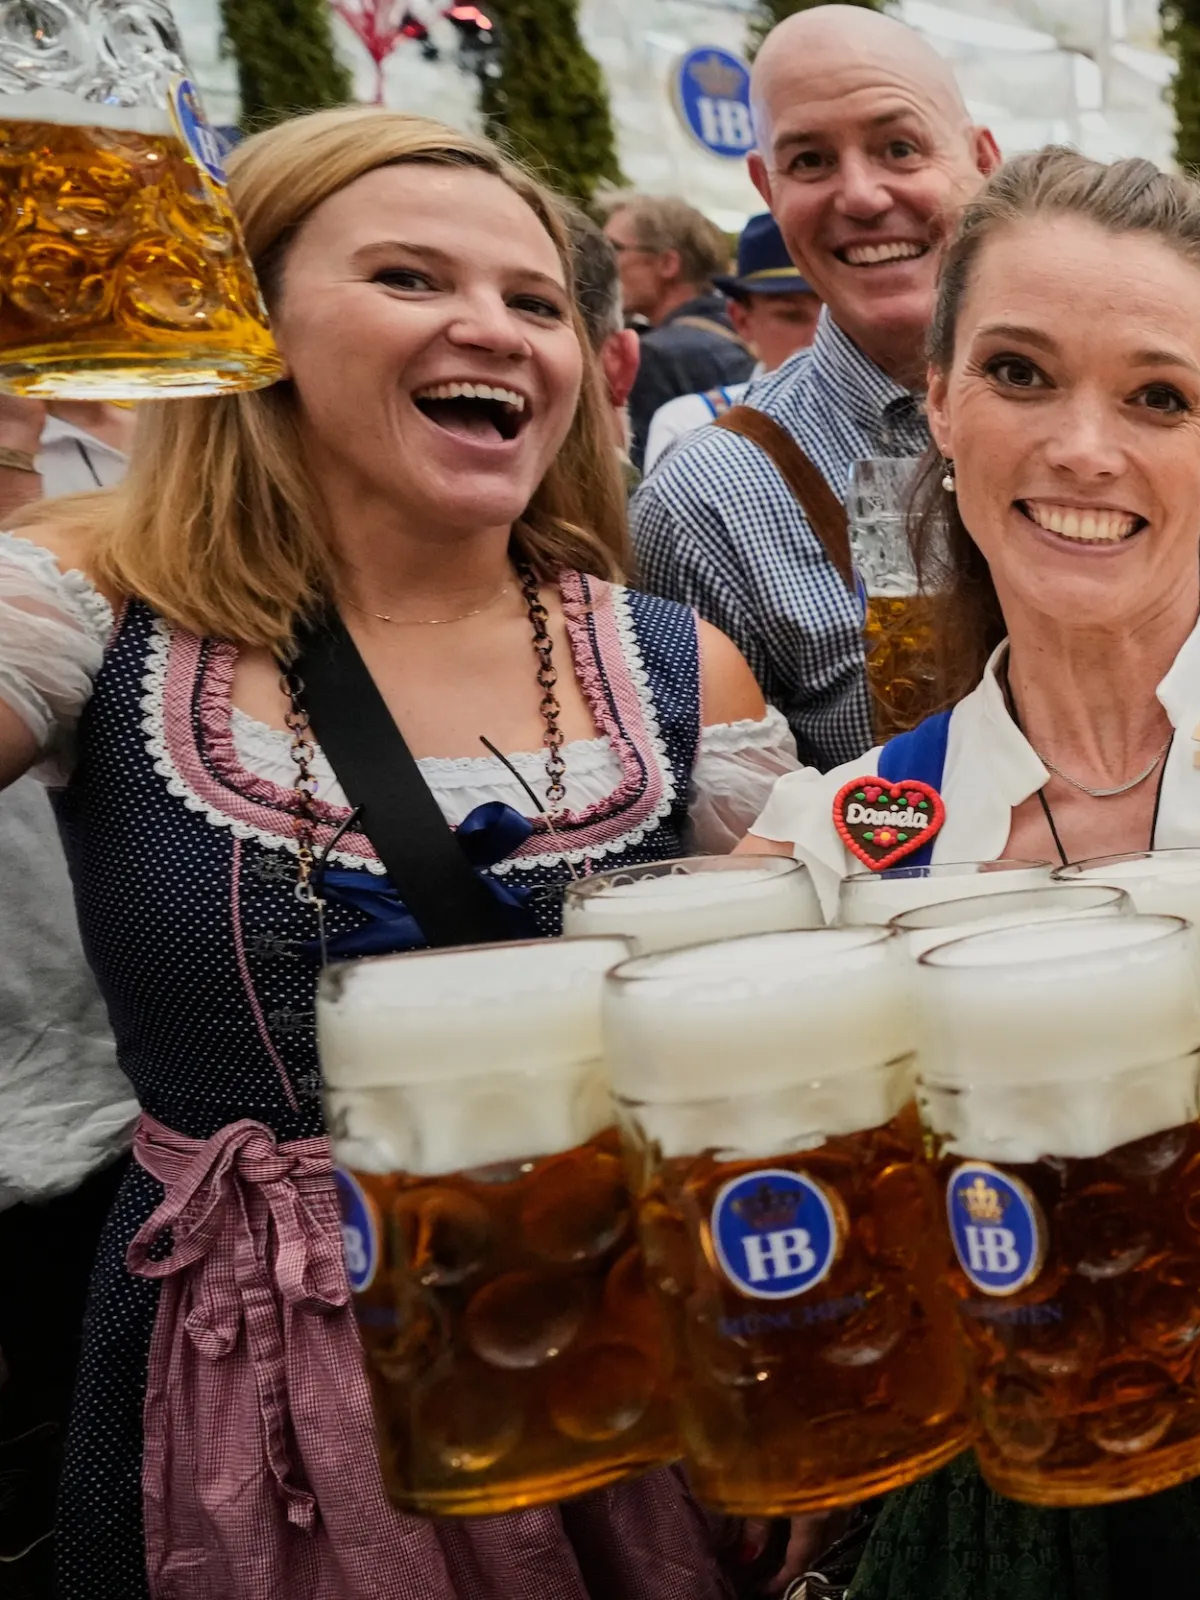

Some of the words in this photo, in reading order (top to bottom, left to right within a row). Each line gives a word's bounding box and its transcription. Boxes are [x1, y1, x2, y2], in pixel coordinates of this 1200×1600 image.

[697, 97, 753, 147] HB
[846, 803, 930, 830] Daniela
[343, 1224, 368, 1274] B
[741, 1228, 816, 1282] HB
[965, 1225, 1021, 1273] HB
